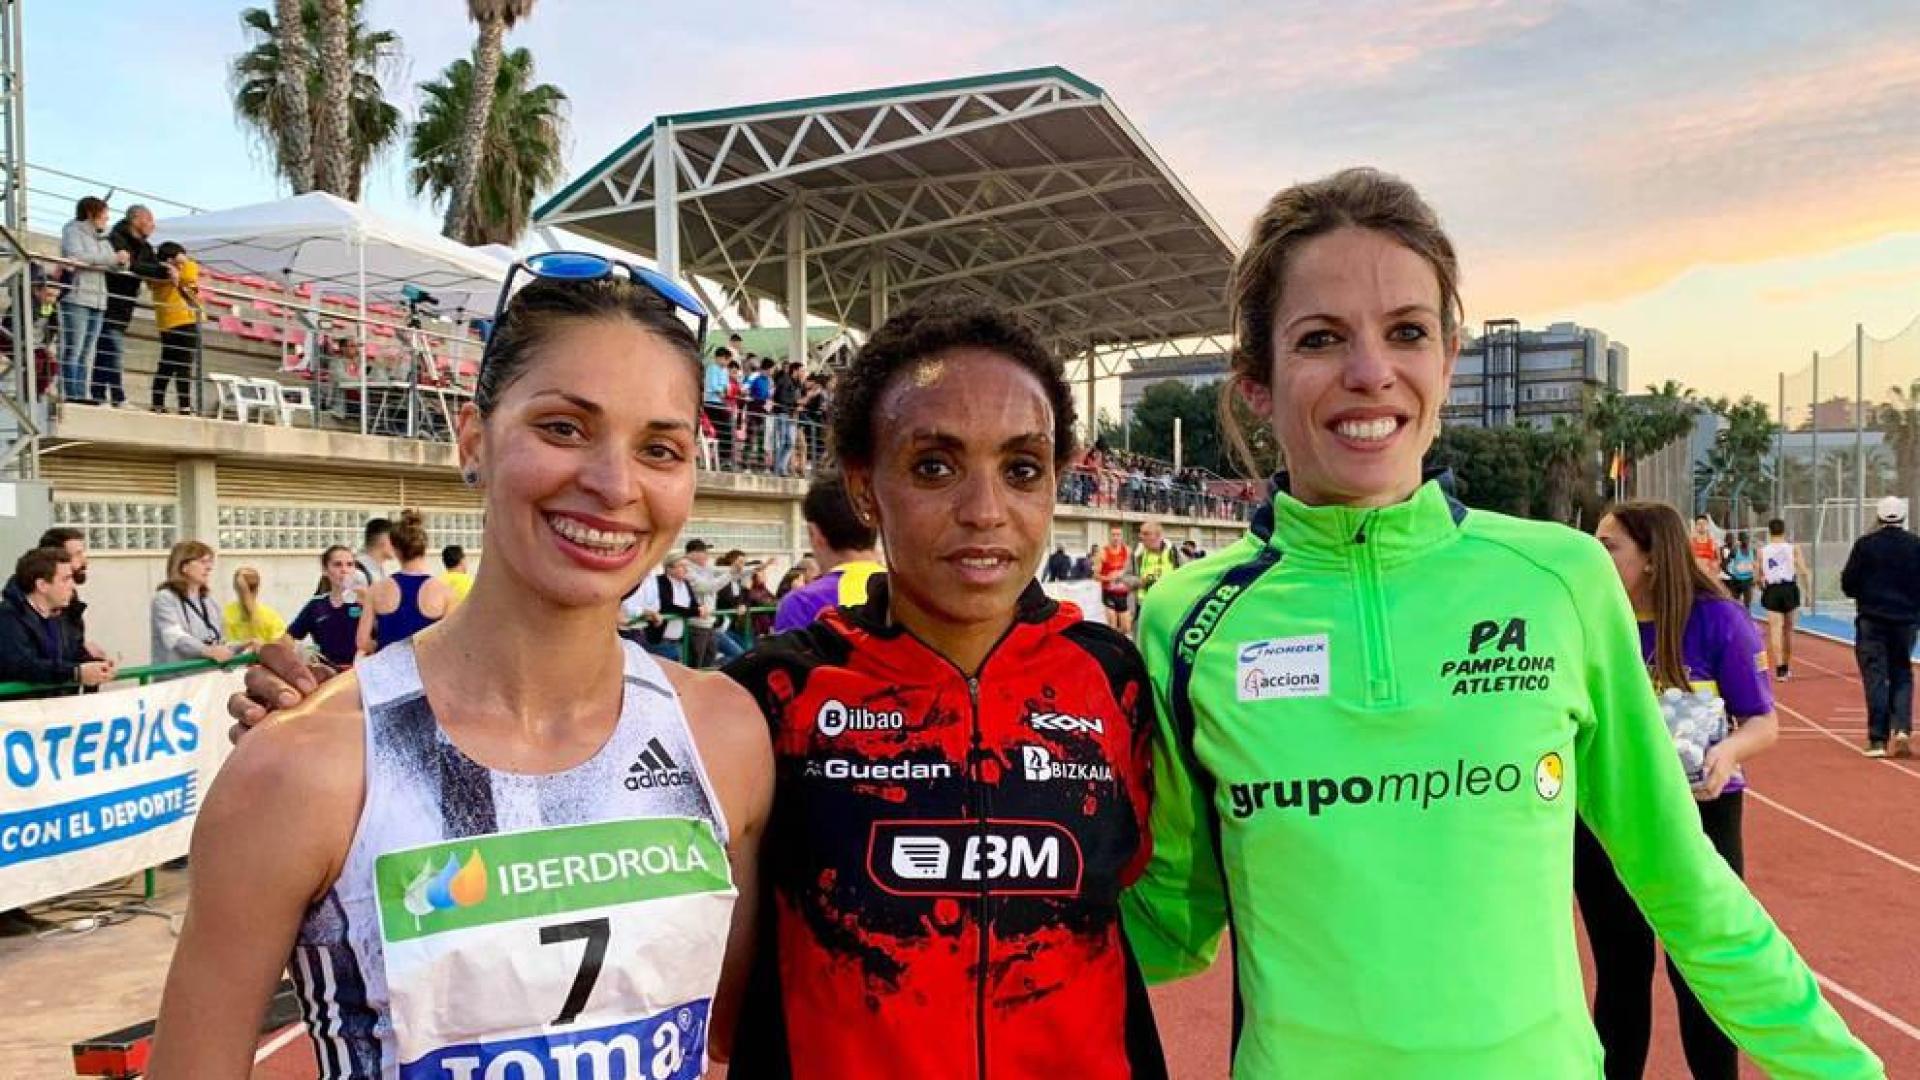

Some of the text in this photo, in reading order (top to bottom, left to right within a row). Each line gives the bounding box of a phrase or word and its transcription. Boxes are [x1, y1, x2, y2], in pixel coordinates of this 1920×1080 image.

[1468, 618, 1526, 654] PA
[1260, 673, 1320, 688] acciona
[1441, 656, 1555, 677] PAMPLONA
[1452, 674, 1549, 696] ATLETICO
[818, 700, 903, 735] Bilbao
[624, 768, 693, 792] adidas
[825, 758, 950, 780] Guedan
[1052, 761, 1114, 781] BIZKAIA
[1231, 758, 1522, 818] grupompleo
[1, 788, 184, 851] CON EL DEPORTE
[499, 844, 708, 895] IBERDROLA
[961, 836, 1060, 880] BM
[539, 917, 611, 1027] 7
